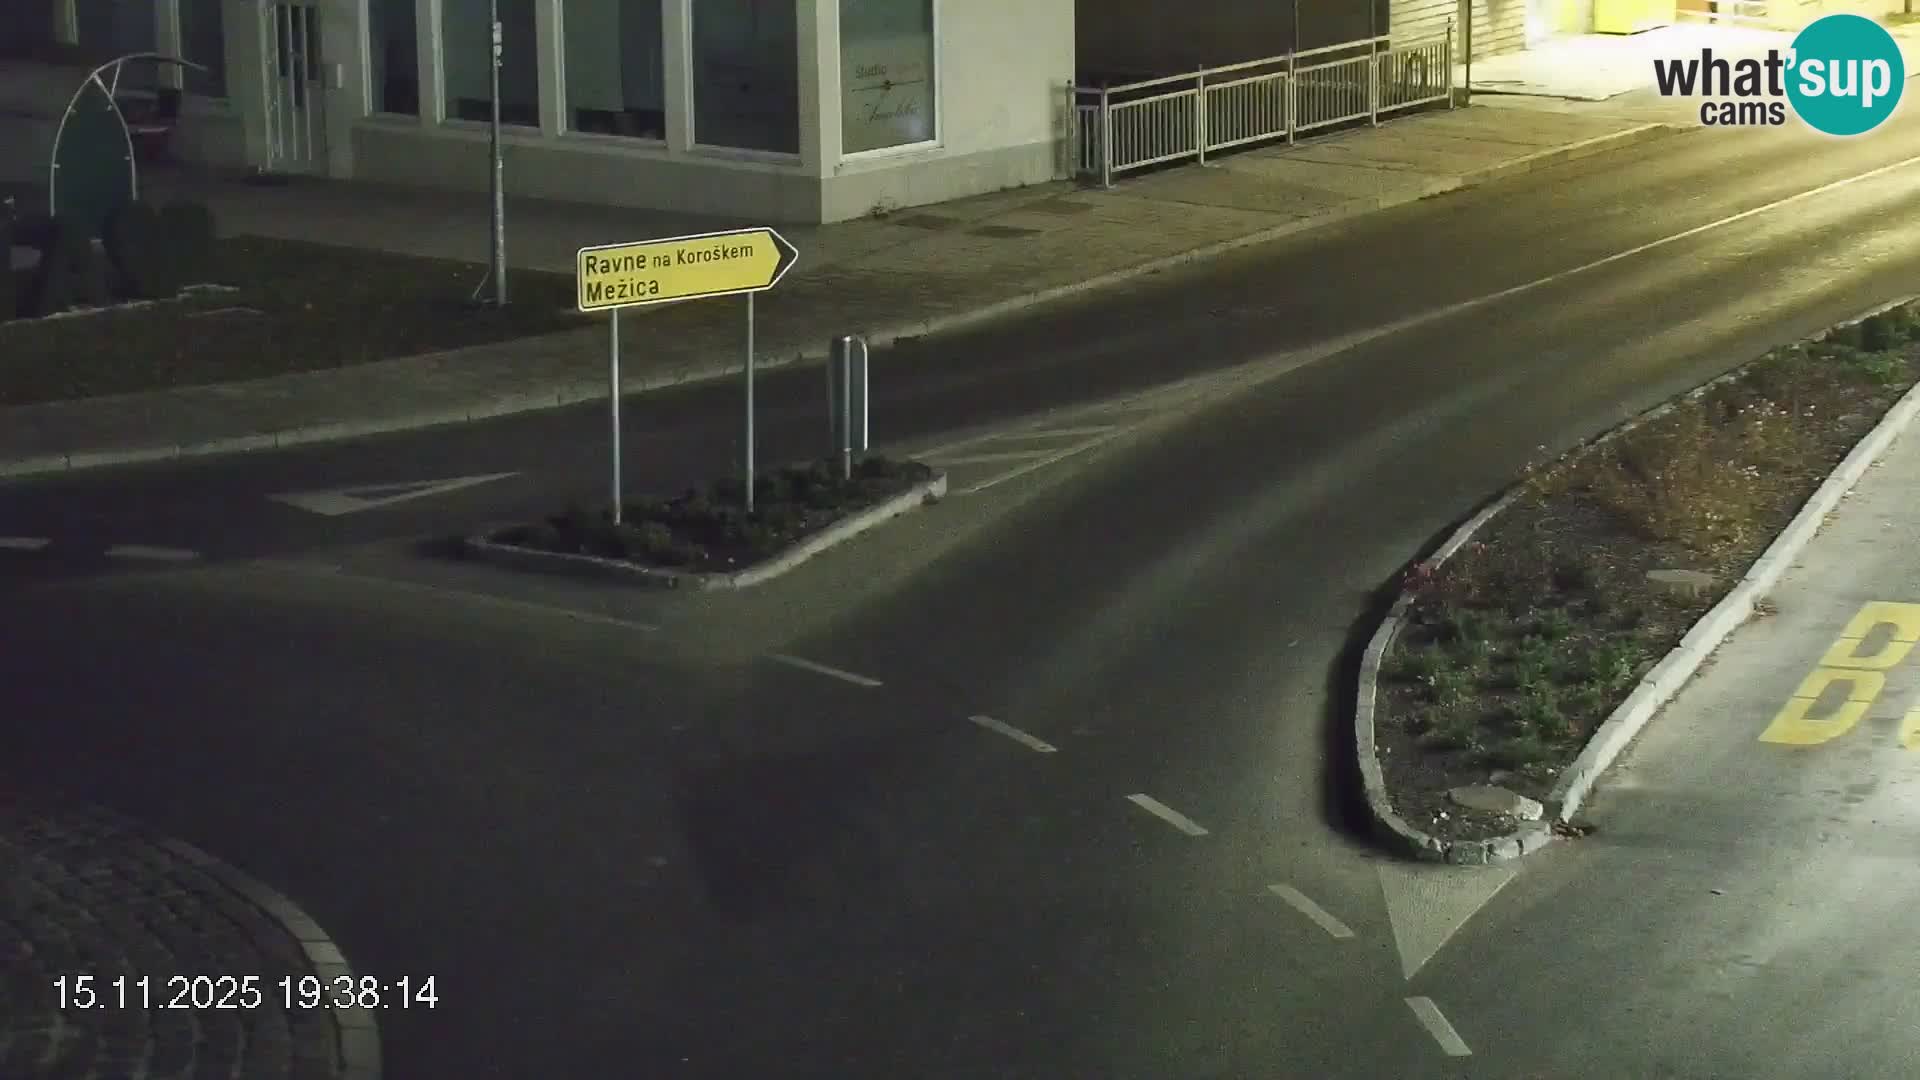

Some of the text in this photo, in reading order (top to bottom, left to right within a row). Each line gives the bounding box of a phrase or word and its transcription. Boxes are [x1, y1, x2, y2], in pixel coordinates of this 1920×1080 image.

[586, 245, 753, 276] Ravne na Koroškem
[586, 279, 659, 303] Mežica
[1758, 601, 1920, 748] B
